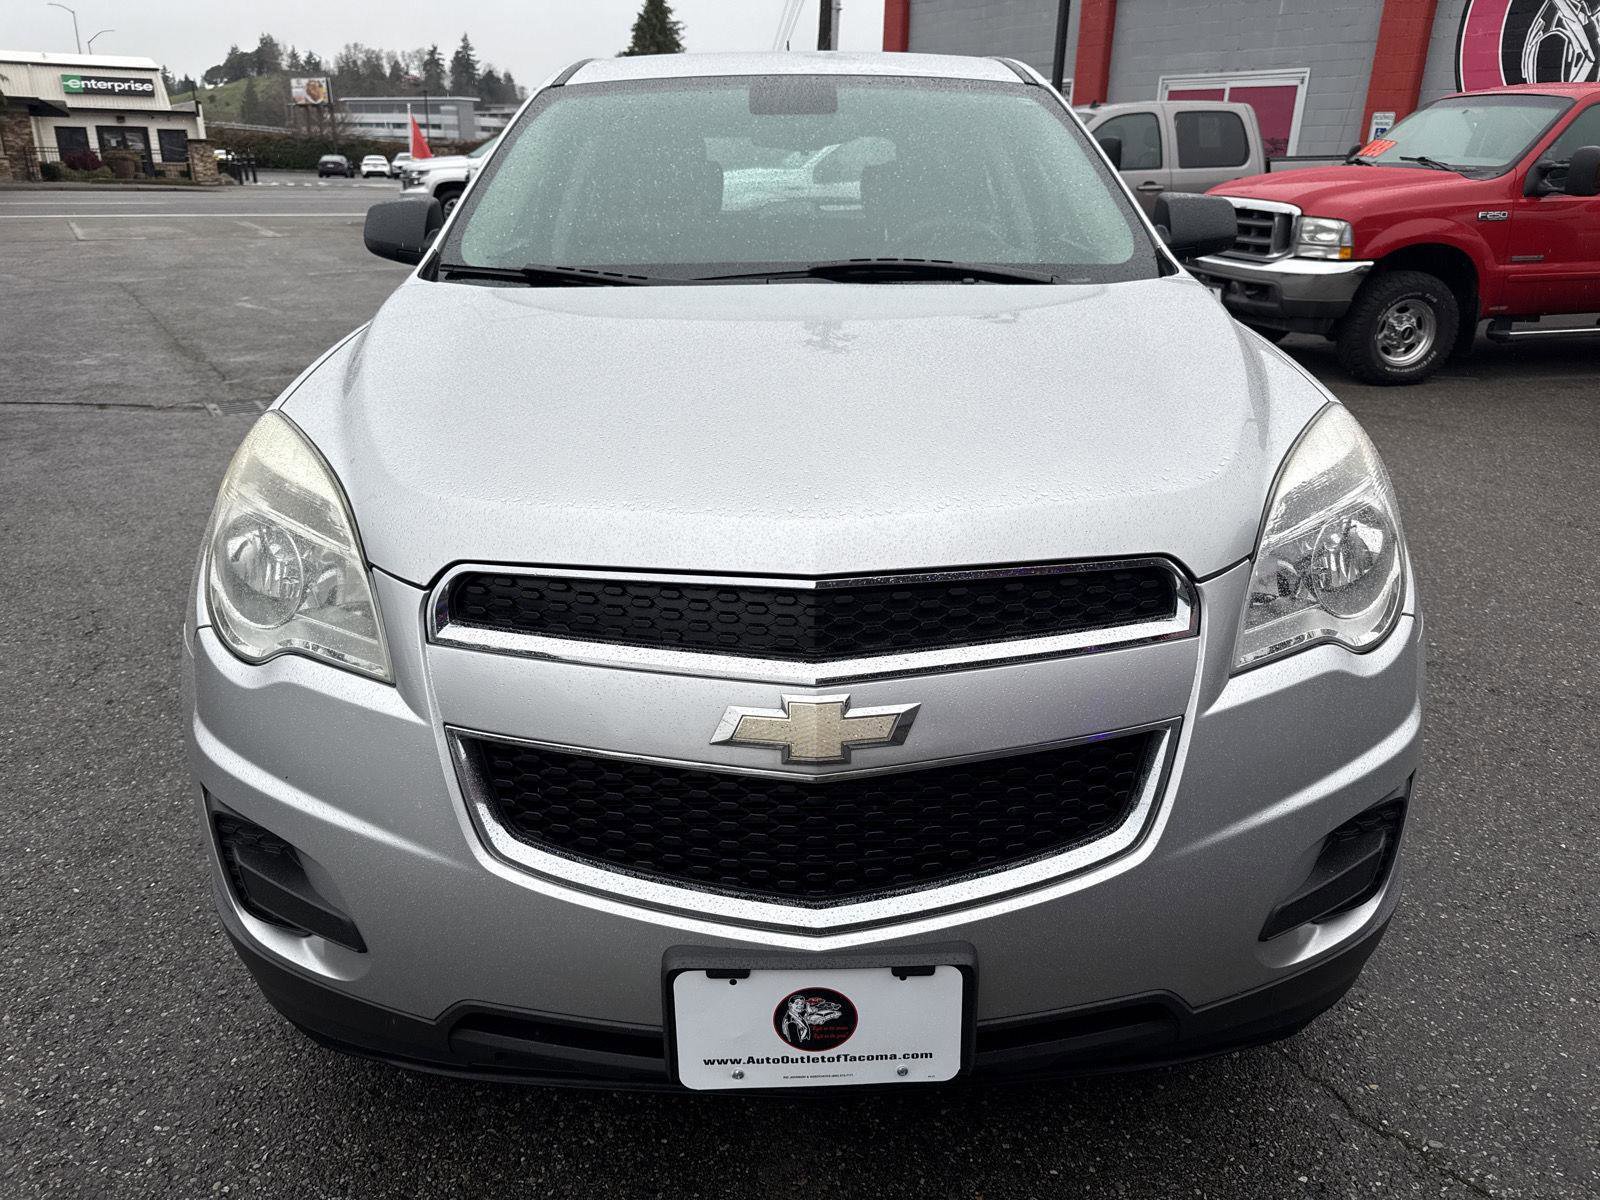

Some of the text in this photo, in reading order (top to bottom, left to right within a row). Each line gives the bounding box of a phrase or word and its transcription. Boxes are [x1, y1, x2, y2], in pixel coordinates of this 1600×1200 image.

[63, 79, 153, 92] enterprise
[1478, 211, 1508, 220] F250
[702, 1052, 933, 1066] www.AutoOutletofTacoma.com
